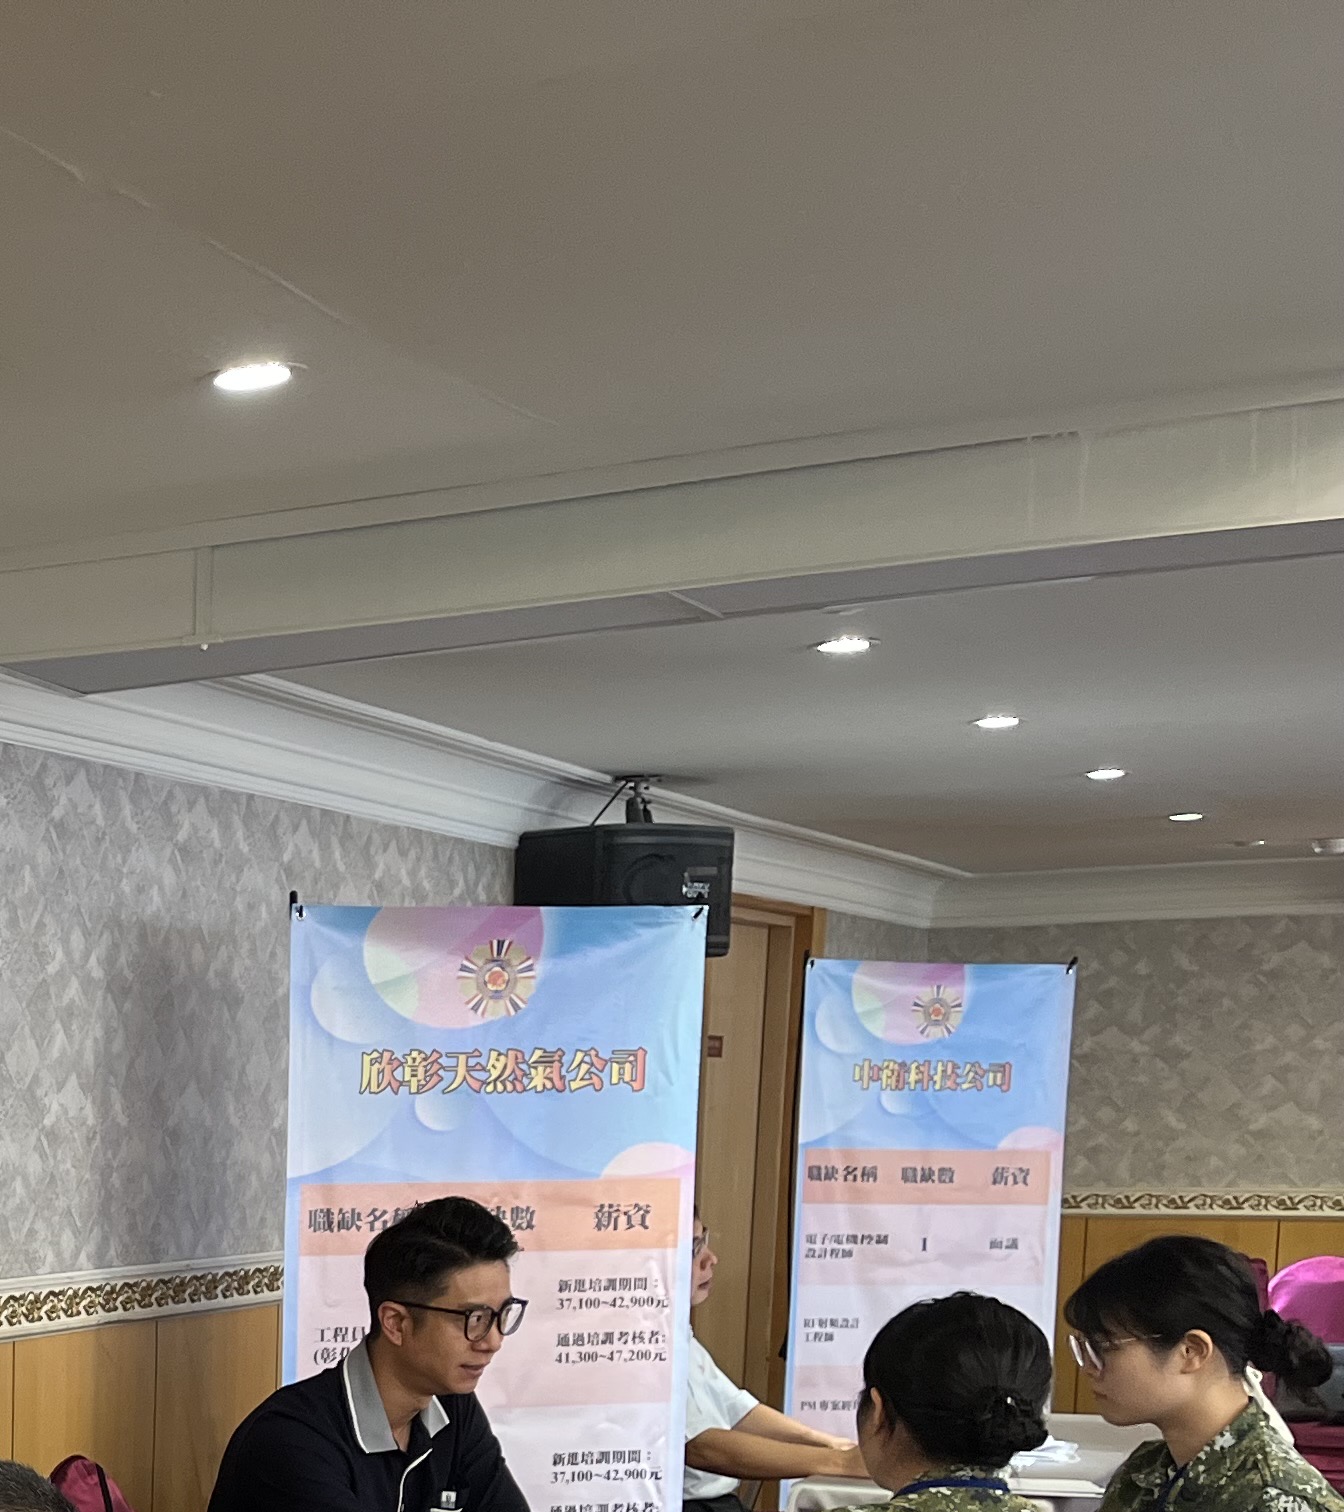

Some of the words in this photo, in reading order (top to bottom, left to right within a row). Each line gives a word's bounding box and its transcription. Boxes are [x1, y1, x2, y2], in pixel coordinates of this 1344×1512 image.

[359, 1047, 647, 1094] 欣彰天然氣公司
[807, 1165, 878, 1183] 職缺名稱
[901, 1166, 955, 1184] 職缺數
[991, 1166, 1031, 1186] 薪資
[593, 1202, 652, 1232] 薪資
